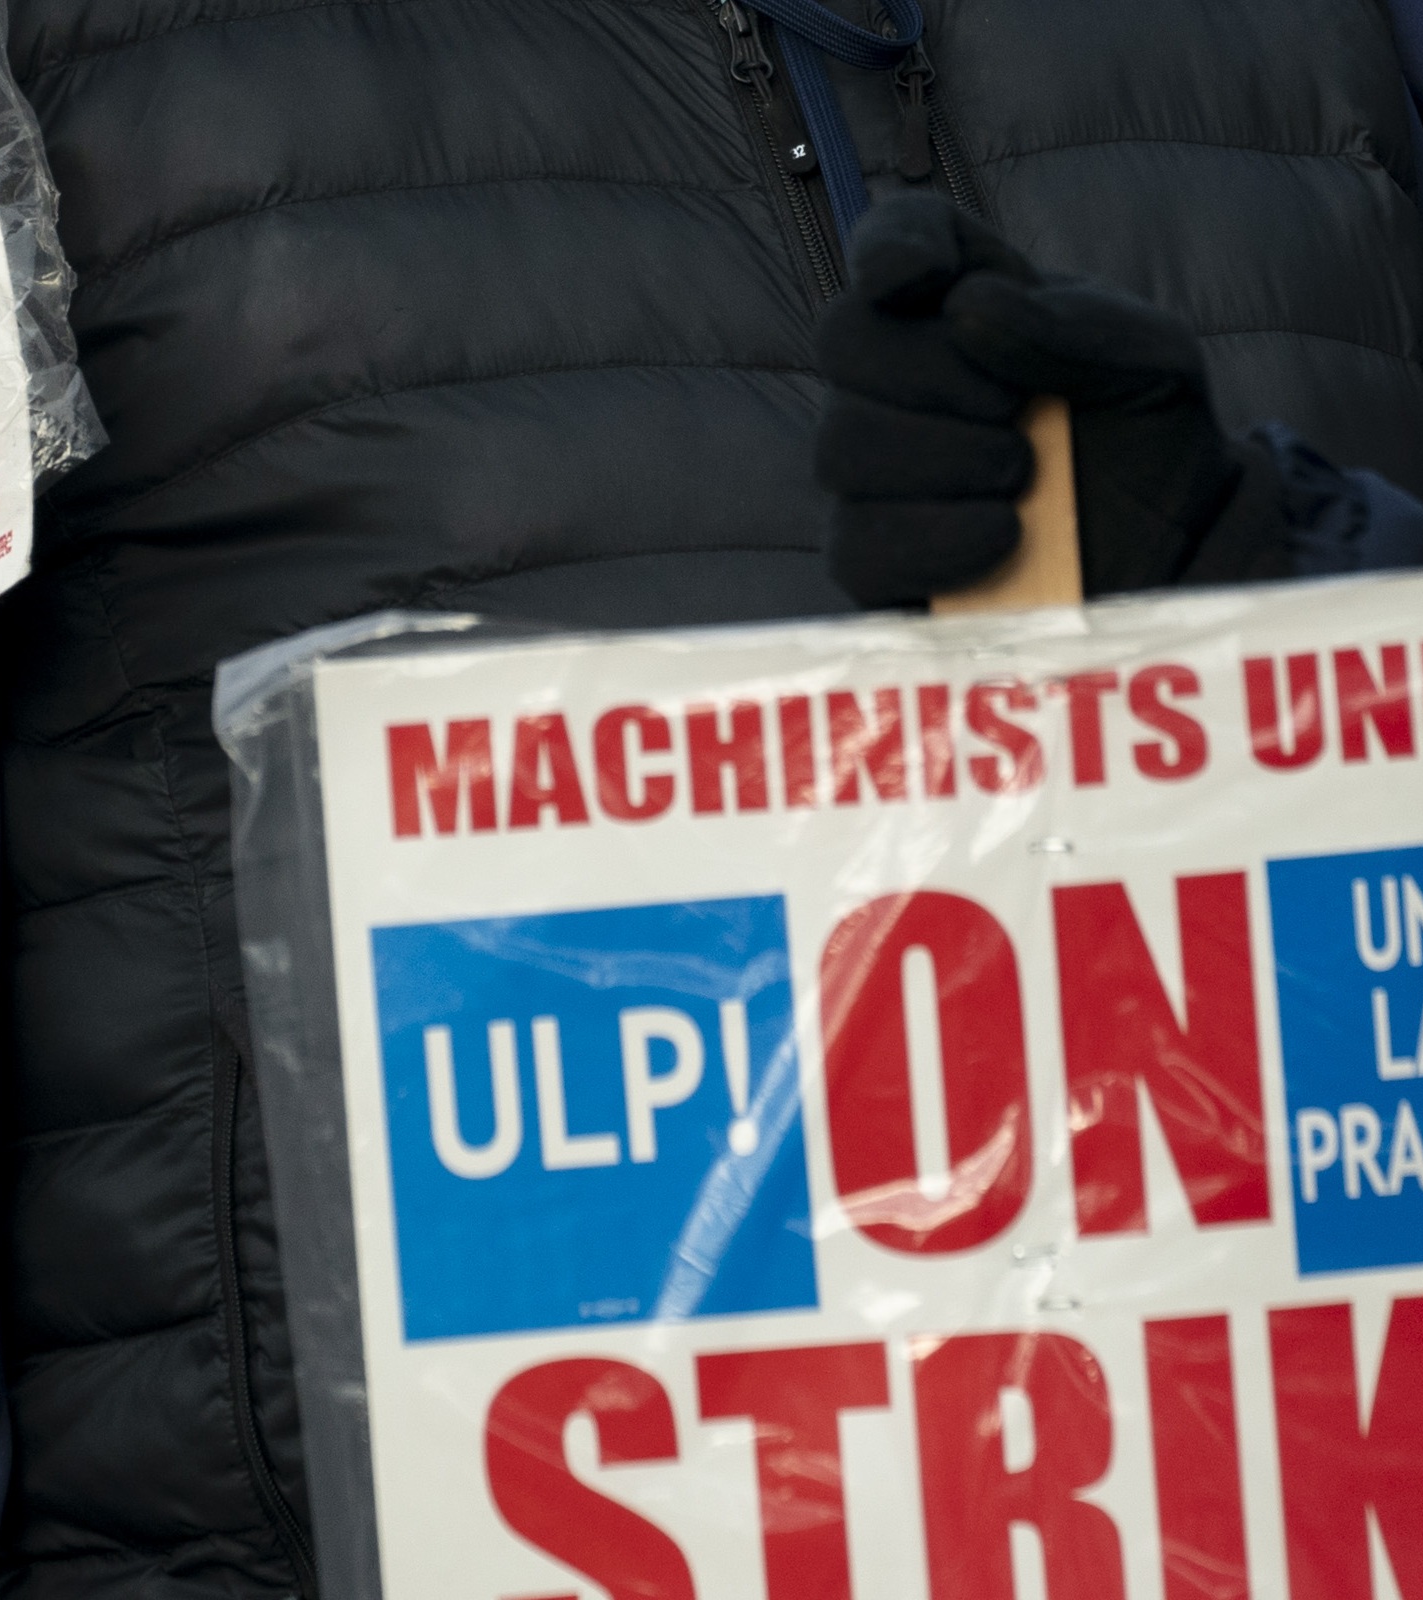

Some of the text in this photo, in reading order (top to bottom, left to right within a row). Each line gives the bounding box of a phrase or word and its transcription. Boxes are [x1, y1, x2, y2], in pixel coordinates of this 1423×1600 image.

[385, 660, 1209, 841] MACHINISTS
[423, 999, 759, 1180] ULP!
[819, 870, 1272, 1258] ON
